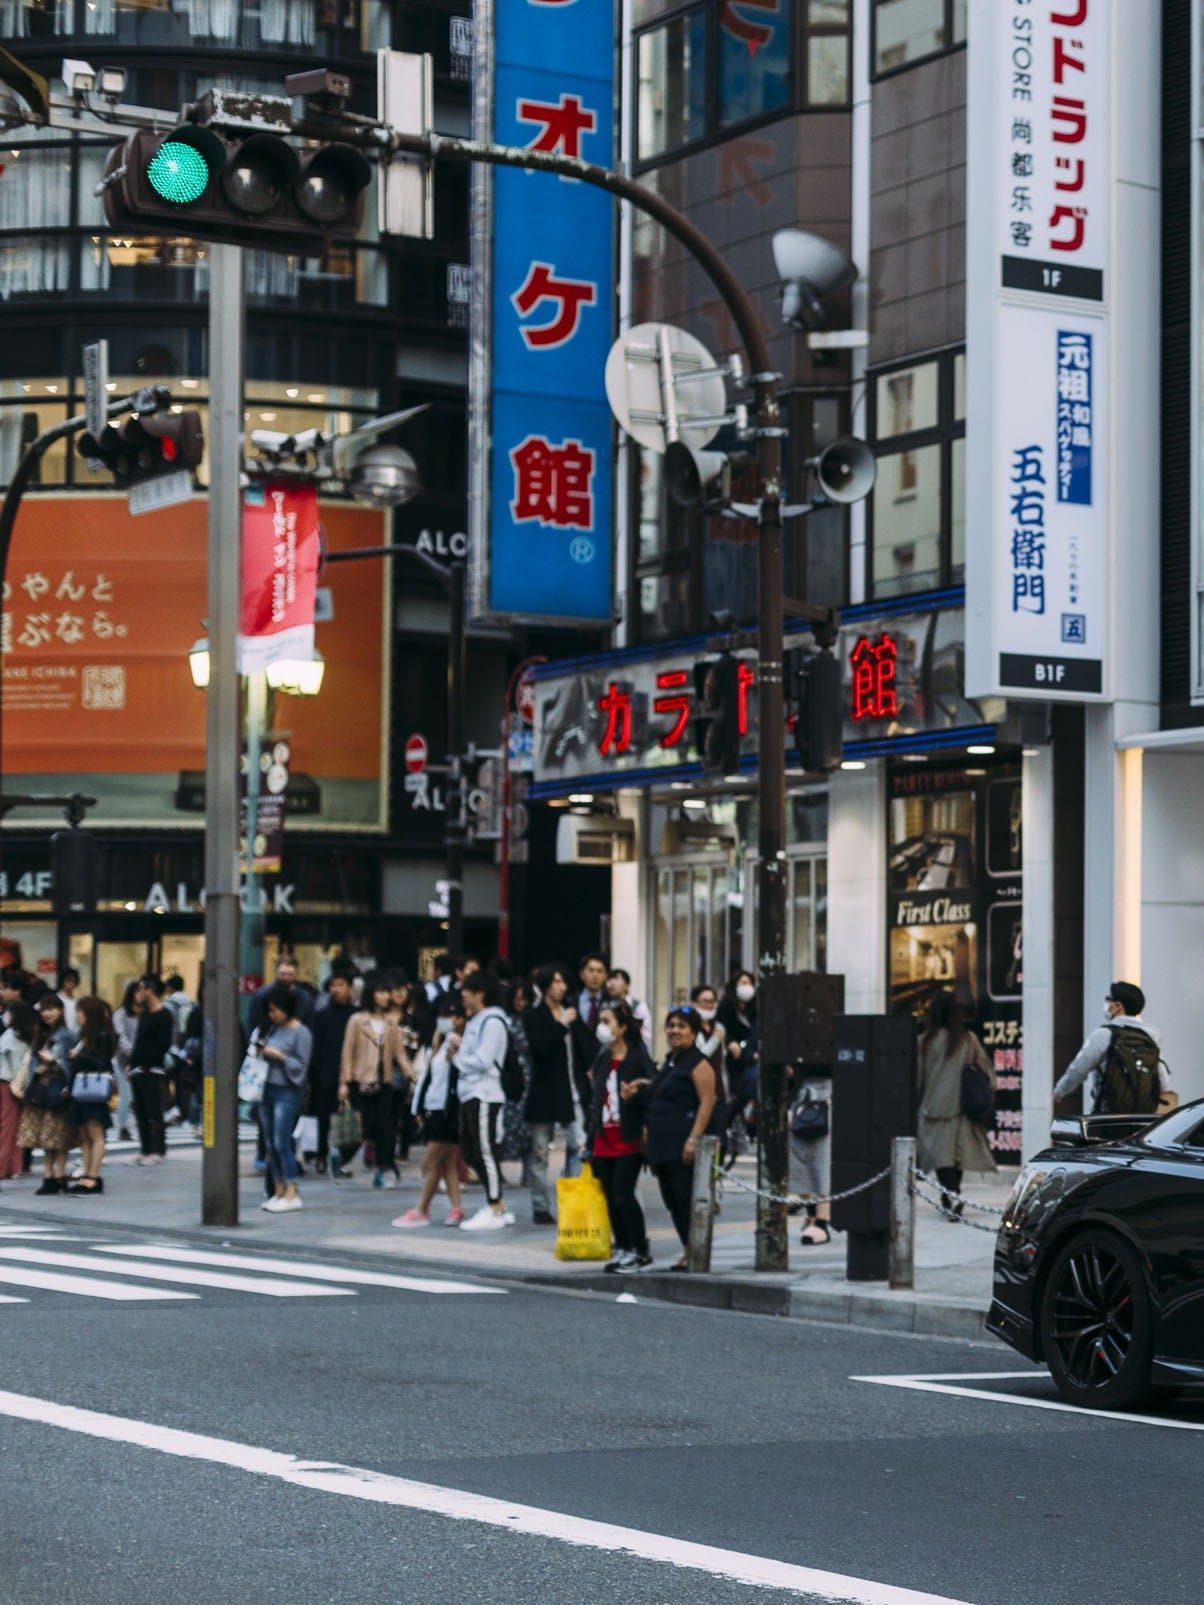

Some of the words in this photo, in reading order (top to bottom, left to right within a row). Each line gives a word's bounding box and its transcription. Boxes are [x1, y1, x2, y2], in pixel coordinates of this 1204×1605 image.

[1011, 16, 1032, 101] STORE
[509, 0, 597, 531] オケ館
[1041, 268, 1063, 288] 1F
[1058, 334, 1091, 402] 元祖
[415, 529, 468, 557] ALO
[1010, 444, 1047, 616] 五右衛門
[2, 611, 129, 653] ぶなら。
[1034, 663, 1066, 683] B1F
[600, 632, 898, 757] カラ館
[15, 871, 53, 898] 4F
[144, 881, 296, 914] ALK
[896, 902, 931, 926] First
[933, 899, 972, 923] Class
[983, 1021, 1023, 1045] コスチ
